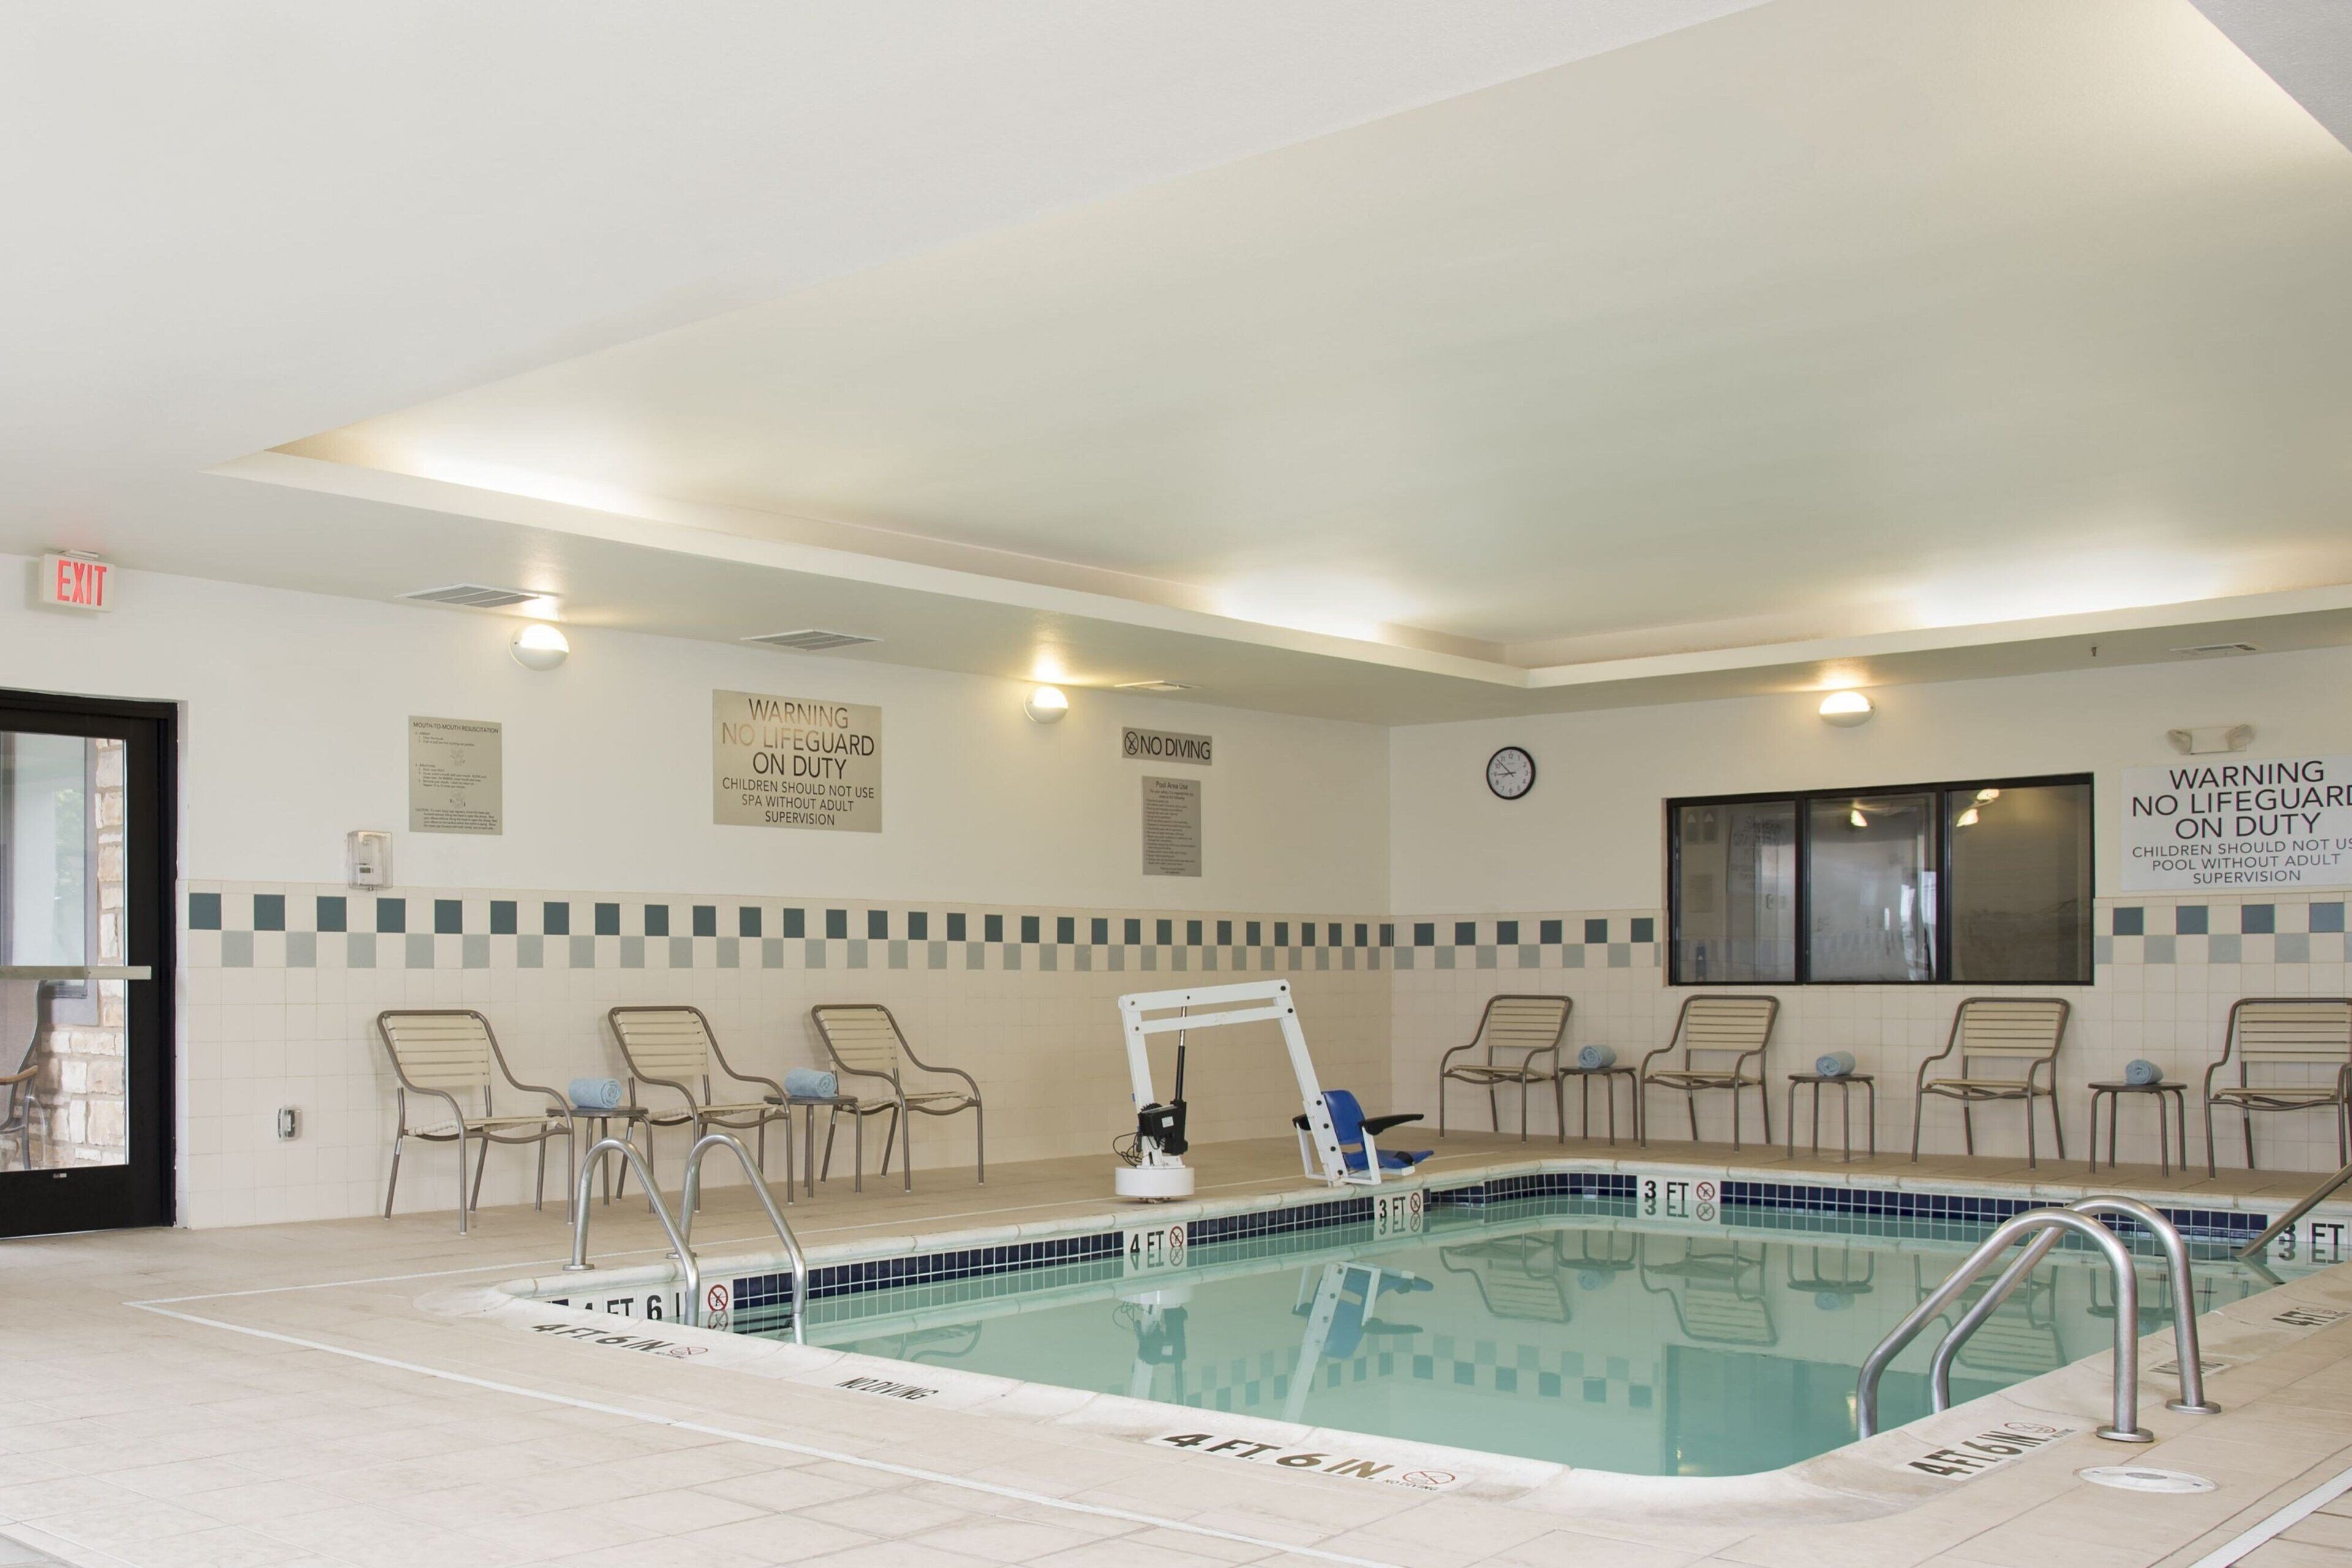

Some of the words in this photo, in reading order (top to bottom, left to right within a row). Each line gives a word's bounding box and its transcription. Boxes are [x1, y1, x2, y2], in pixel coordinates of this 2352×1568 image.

[57, 560, 107, 606] EXIT
[748, 698, 848, 729] WARNING
[461, 725, 499, 734] RESUSCITATION
[722, 722, 755, 746] NO
[763, 726, 875, 756] LIFEGUARD
[1140, 735, 1162, 755] NO
[1165, 737, 1210, 760] DIVING
[753, 752, 785, 775] ON
[793, 755, 846, 780] DUTY
[2169, 760, 2324, 790] WARNING
[722, 777, 778, 793] CHILDREN
[782, 781, 826, 796] SHOULD
[829, 785, 851, 798] NOT
[855, 786, 875, 799] USE
[742, 794, 763, 807] SPA
[766, 796, 816, 810] WITHOUT
[820, 799, 854, 812] ADULT
[2132, 794, 2178, 817] NO
[764, 810, 835, 826] SUPERVISION
[2175, 818, 2222, 840] ON
[2236, 812, 2321, 837] DUTY
[2132, 844, 2212, 858] CHILDREN
[2218, 841, 2286, 855] SHOULD
[2293, 839, 2329, 851] NOT
[2152, 859, 2196, 871] POOL
[2201, 856, 2279, 870] WITHOUT
[2285, 853, 2341, 867] ADULT
[2193, 869, 2301, 884] SUPERVISION
[1645, 1180, 1656, 1199] 3
[1667, 1182, 1689, 1201] FT
[1379, 1199, 1387, 1218] 3
[1392, 1196, 1406, 1217] FT
[1130, 1234, 1140, 1254] 4
[1147, 1231, 1164, 1252] FT
[2312, 1223, 2345, 1245] FT
[647, 1295, 663, 1319] 6
[531, 1324, 571, 1332] 4
[595, 1335, 641, 1344] 6
[1162, 1434, 1215, 1447] 4
[1204, 1439, 1283, 1460] FT.
[1276, 1453, 1332, 1468] 6
[1322, 1458, 1395, 1480] IN.
[1907, 1461, 1973, 1476] 4
[1961, 1441, 2023, 1455] 6
